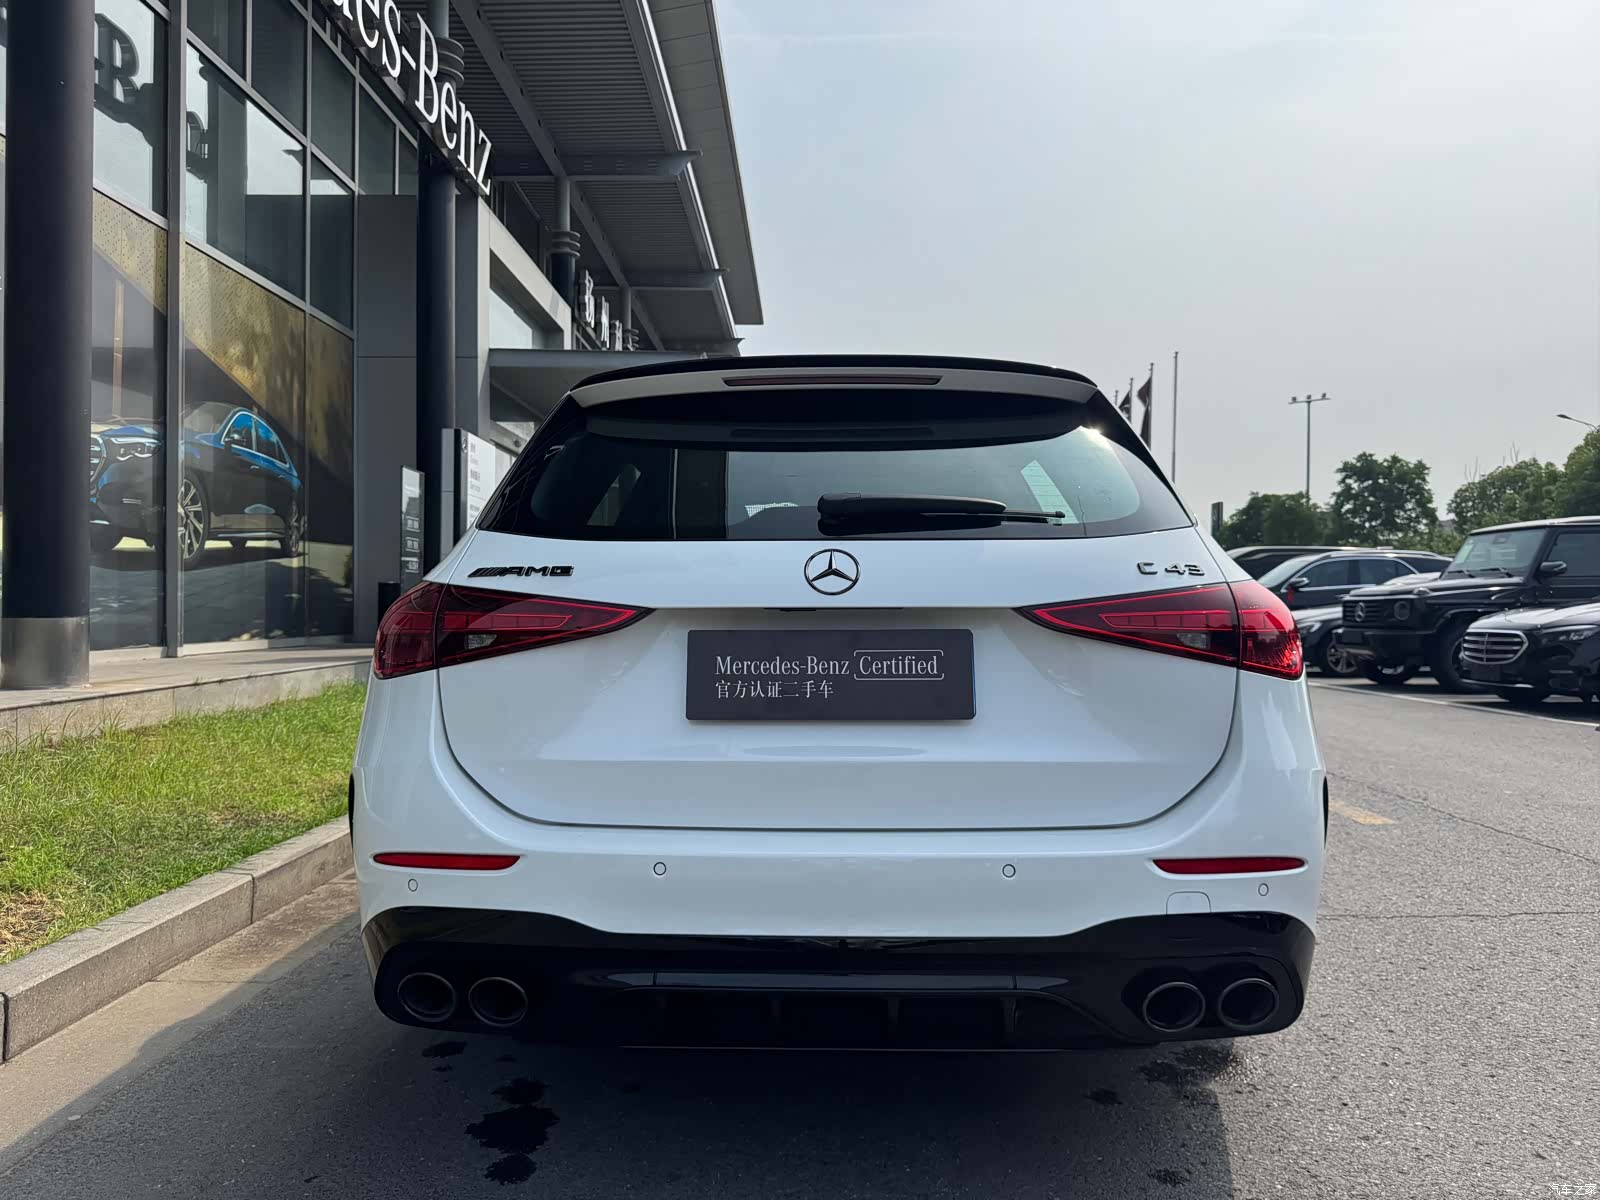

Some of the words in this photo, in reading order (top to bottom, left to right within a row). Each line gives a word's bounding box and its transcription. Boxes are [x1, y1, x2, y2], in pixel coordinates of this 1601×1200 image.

[333, 0, 492, 195] es-Benz
[1137, 562, 1158, 575] C
[1164, 563, 1205, 576] 43
[715, 656, 850, 675] Mercedes-Benz
[859, 656, 938, 675] Certified
[715, 680, 834, 699] 官方认证二手车
